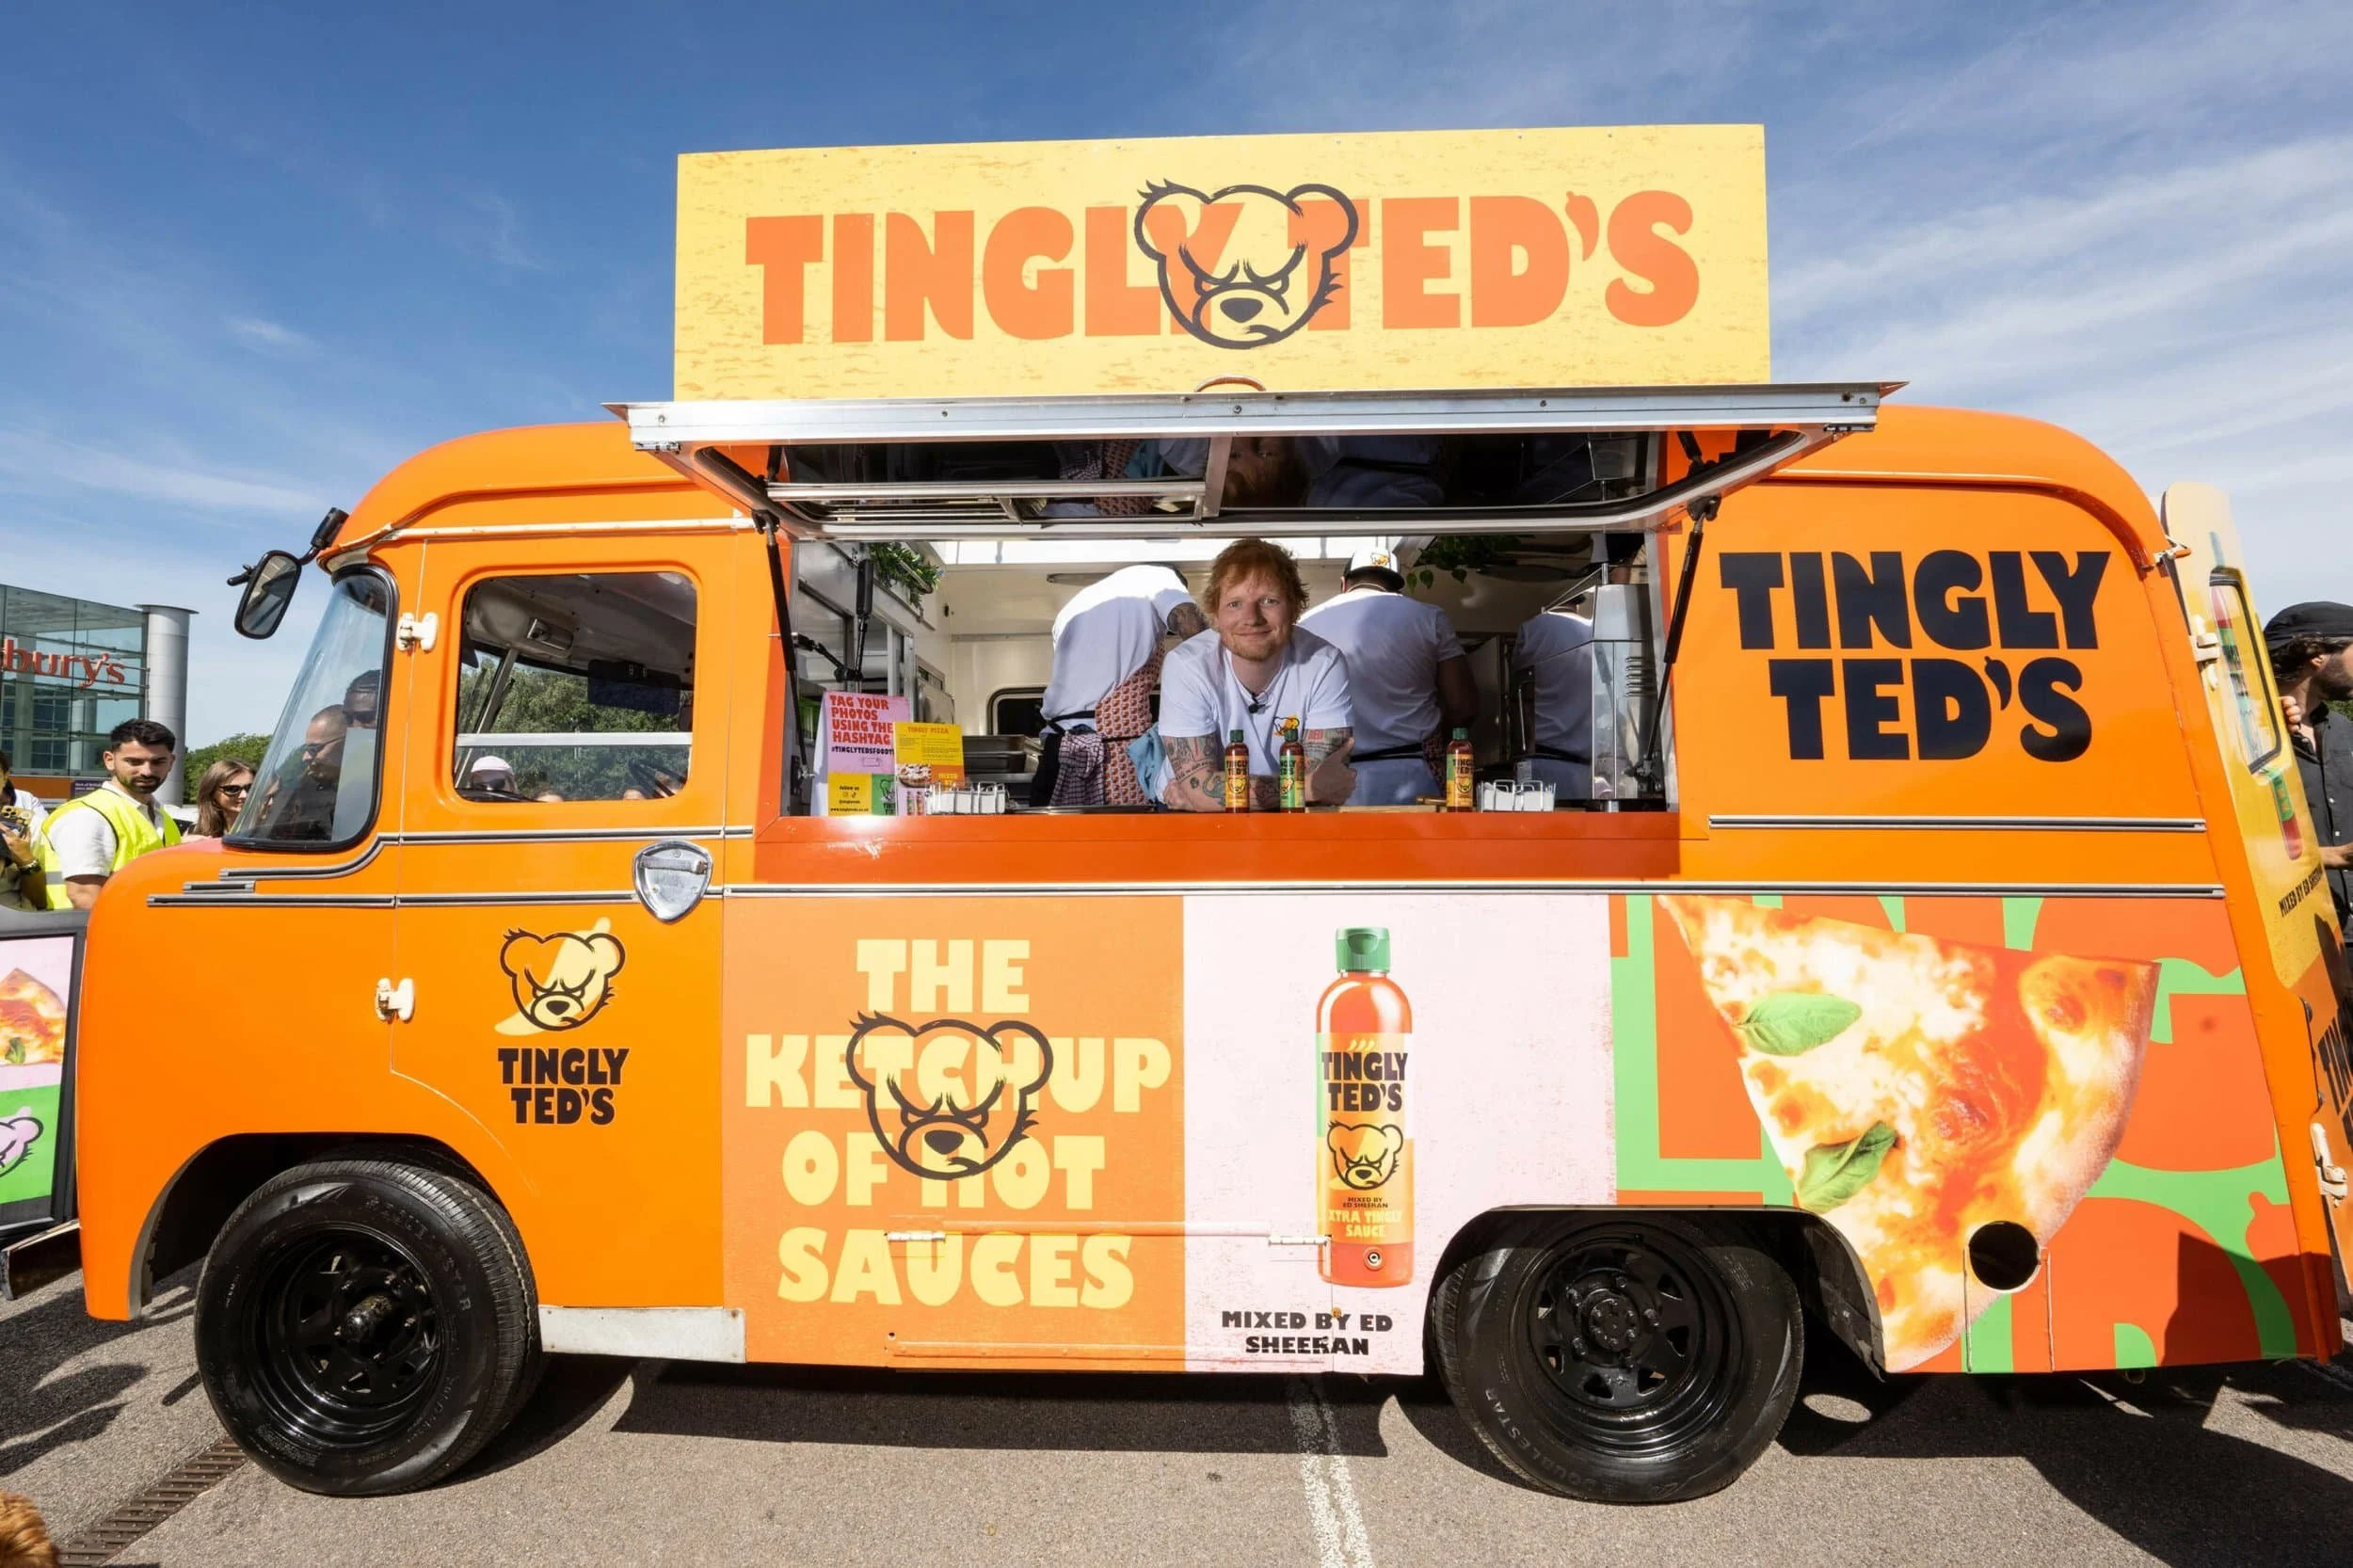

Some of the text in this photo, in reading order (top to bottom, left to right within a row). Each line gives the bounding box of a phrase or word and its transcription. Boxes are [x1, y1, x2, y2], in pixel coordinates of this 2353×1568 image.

[745, 189, 1700, 345] TINGLY TED'S
[1719, 550, 2111, 650] TINGLY
[829, 695, 889, 711] TAG YOUR
[831, 707, 878, 721] PHOTOS
[1768, 655, 2092, 762] TED'S
[832, 718, 893, 733] USING THE
[833, 730, 890, 745] HASHTAG
[856, 938, 1031, 1014] THE
[498, 1048, 630, 1085] TINGLY
[745, 1033, 1172, 1113] KETCHUP
[1321, 1051, 1408, 1081] TINGLY
[511, 1087, 616, 1126] TED'S
[1328, 1082, 1402, 1112] TED'S
[782, 1129, 1106, 1210] OF HOT
[1328, 1208, 1361, 1224] XTRA
[1345, 1224, 1386, 1238] SAUCE
[776, 1226, 1135, 1310] SAUCES
[1222, 1311, 1393, 1333] MIXED BY ED
[1245, 1336, 1369, 1355] SHEERAN
